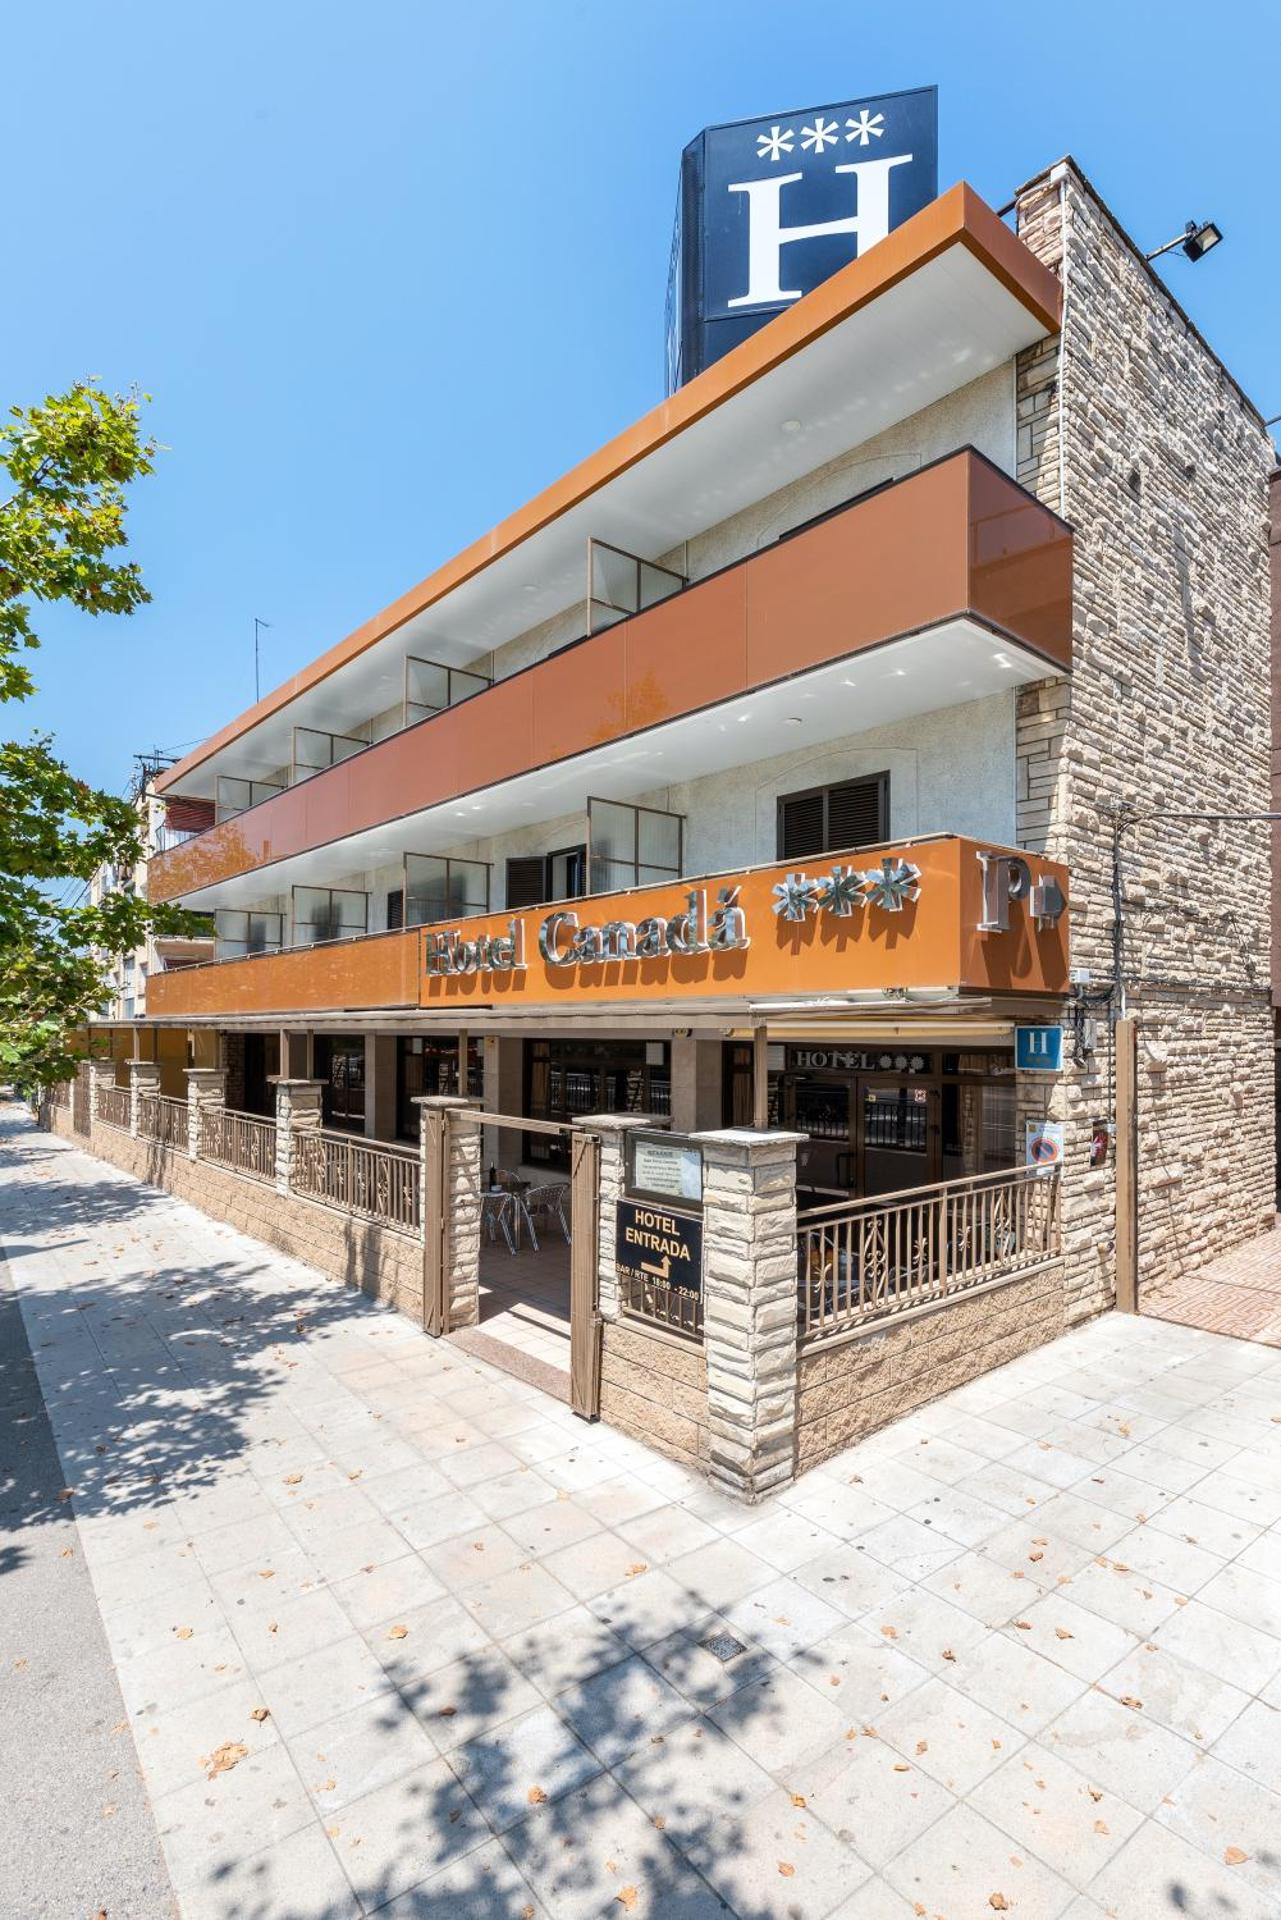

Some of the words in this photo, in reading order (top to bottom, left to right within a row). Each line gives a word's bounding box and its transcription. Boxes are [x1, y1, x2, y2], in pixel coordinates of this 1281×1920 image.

[727, 153, 914, 308] H
[976, 850, 1031, 934] P
[425, 917, 529, 977] Hotel
[538, 885, 752, 968] Canadá
[796, 1050, 876, 1071] HOTEL
[625, 1227, 691, 1262] ENTRADA
[635, 1209, 681, 1236] HOTEL
